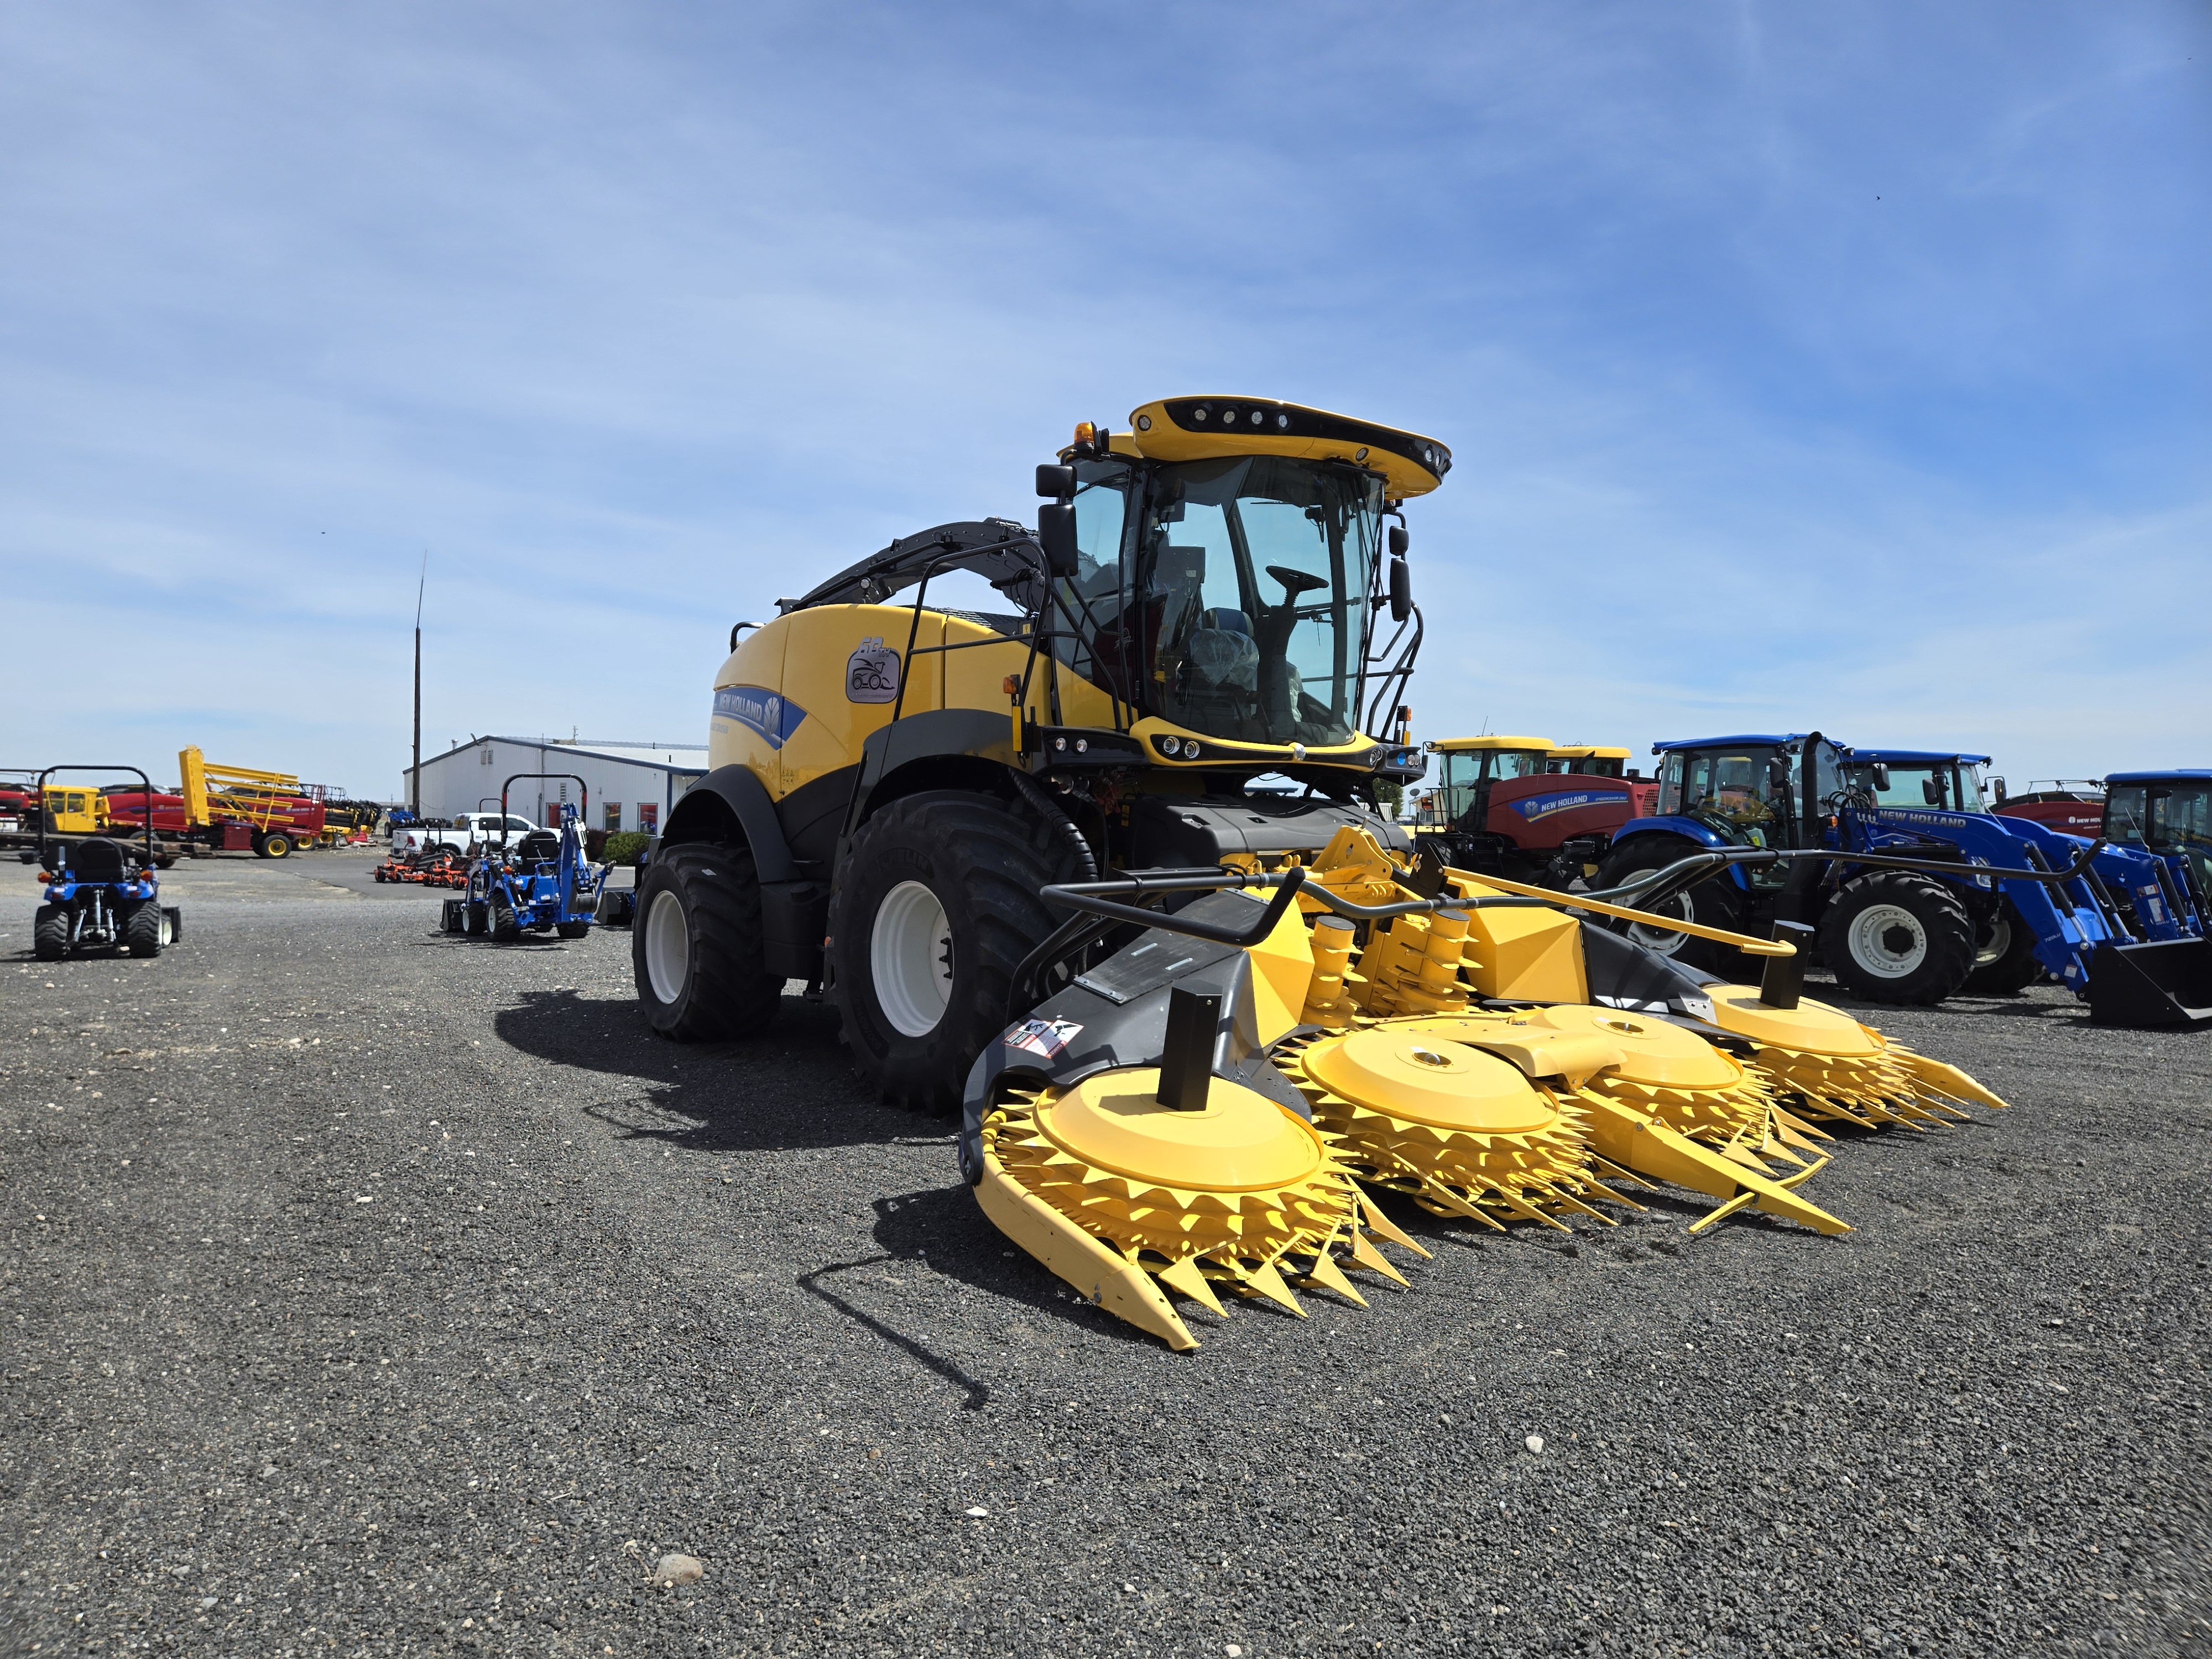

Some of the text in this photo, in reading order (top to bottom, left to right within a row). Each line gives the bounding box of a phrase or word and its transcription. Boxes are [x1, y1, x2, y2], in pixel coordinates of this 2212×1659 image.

[718, 693, 763, 722] NEW HOLLAND
[1541, 802, 1557, 812] NEW
[1558, 795, 1588, 807] HOLLAND
[1879, 810, 1966, 828] NEW HOLLAND
[2044, 932, 2061, 943] 720LU
